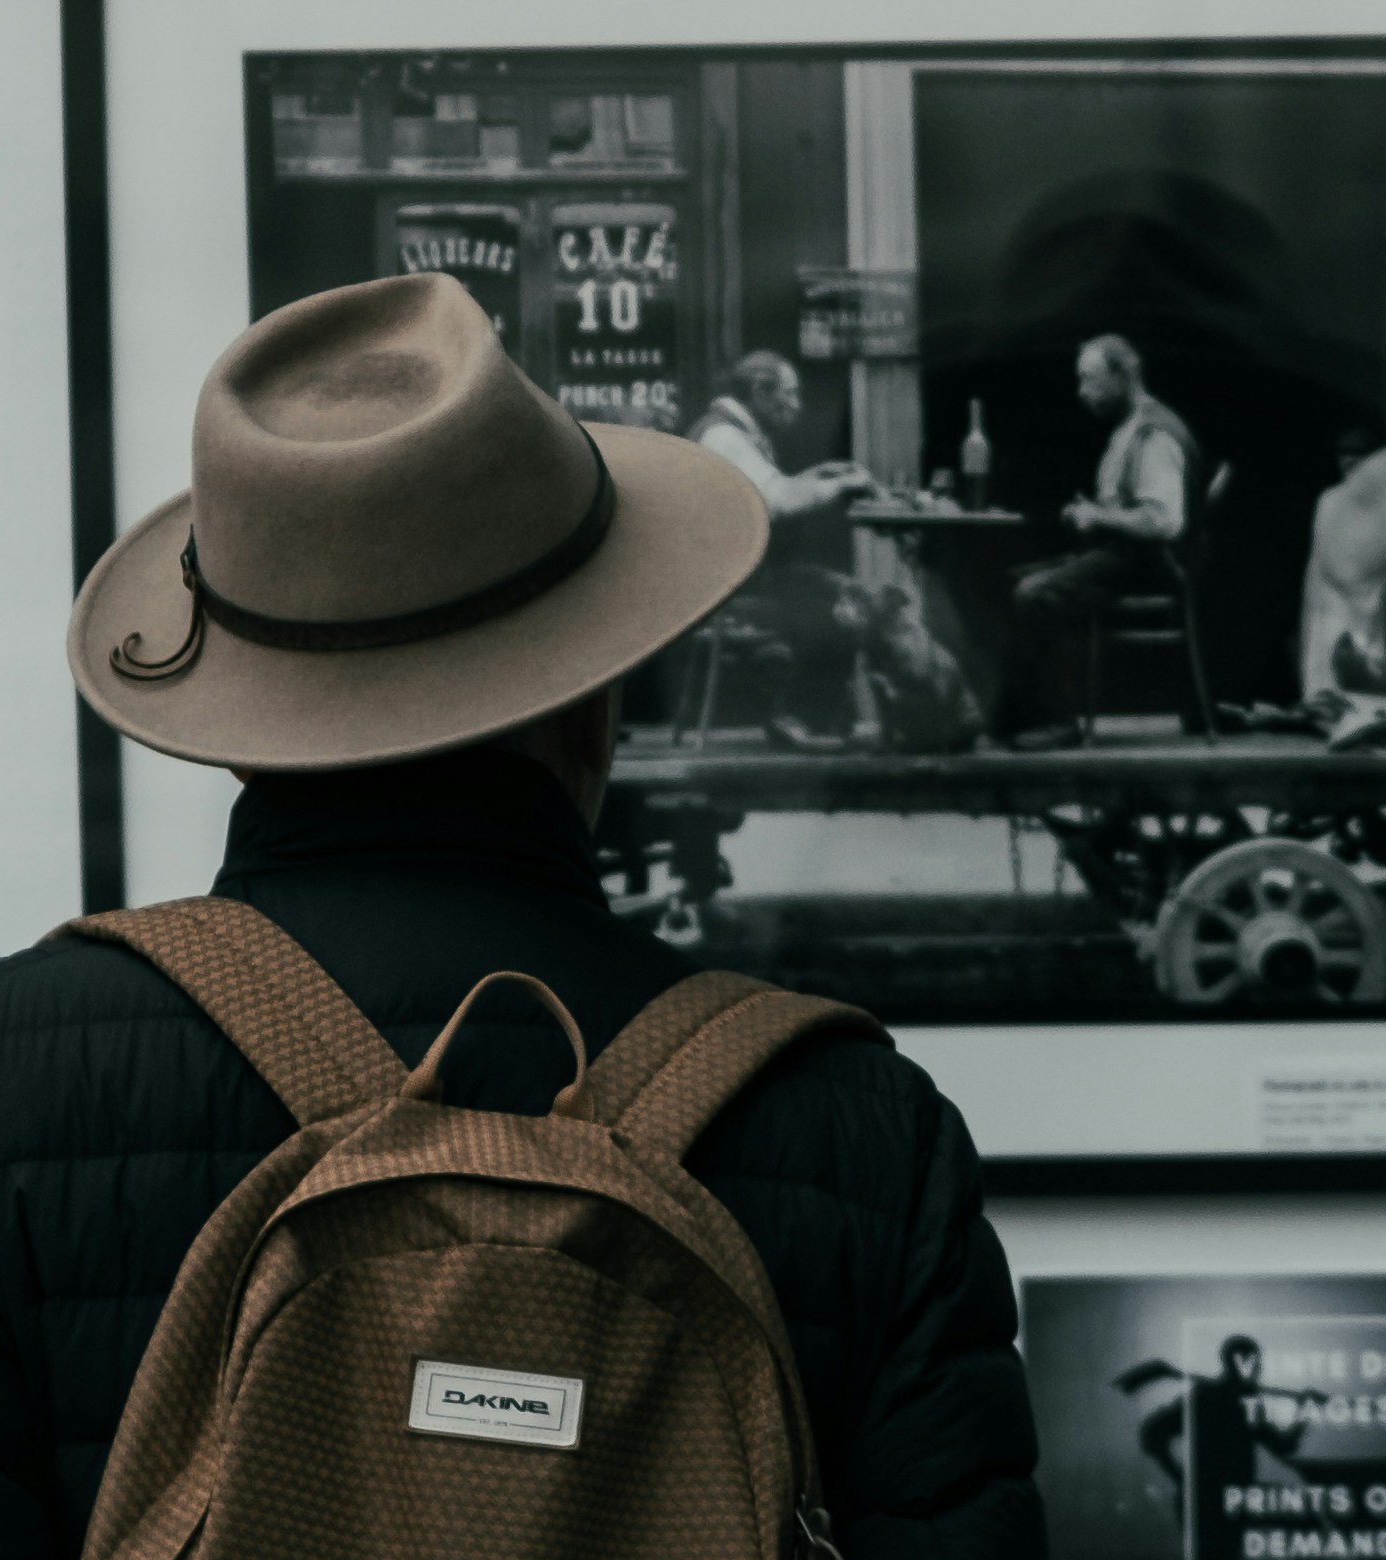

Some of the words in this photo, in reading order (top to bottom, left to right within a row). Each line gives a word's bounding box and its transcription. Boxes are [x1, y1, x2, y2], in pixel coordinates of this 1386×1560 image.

[556, 221, 667, 271] CAFÉ
[442, 1389, 550, 1416] DAKINE
[1223, 1485, 1353, 1515] PRINTS
